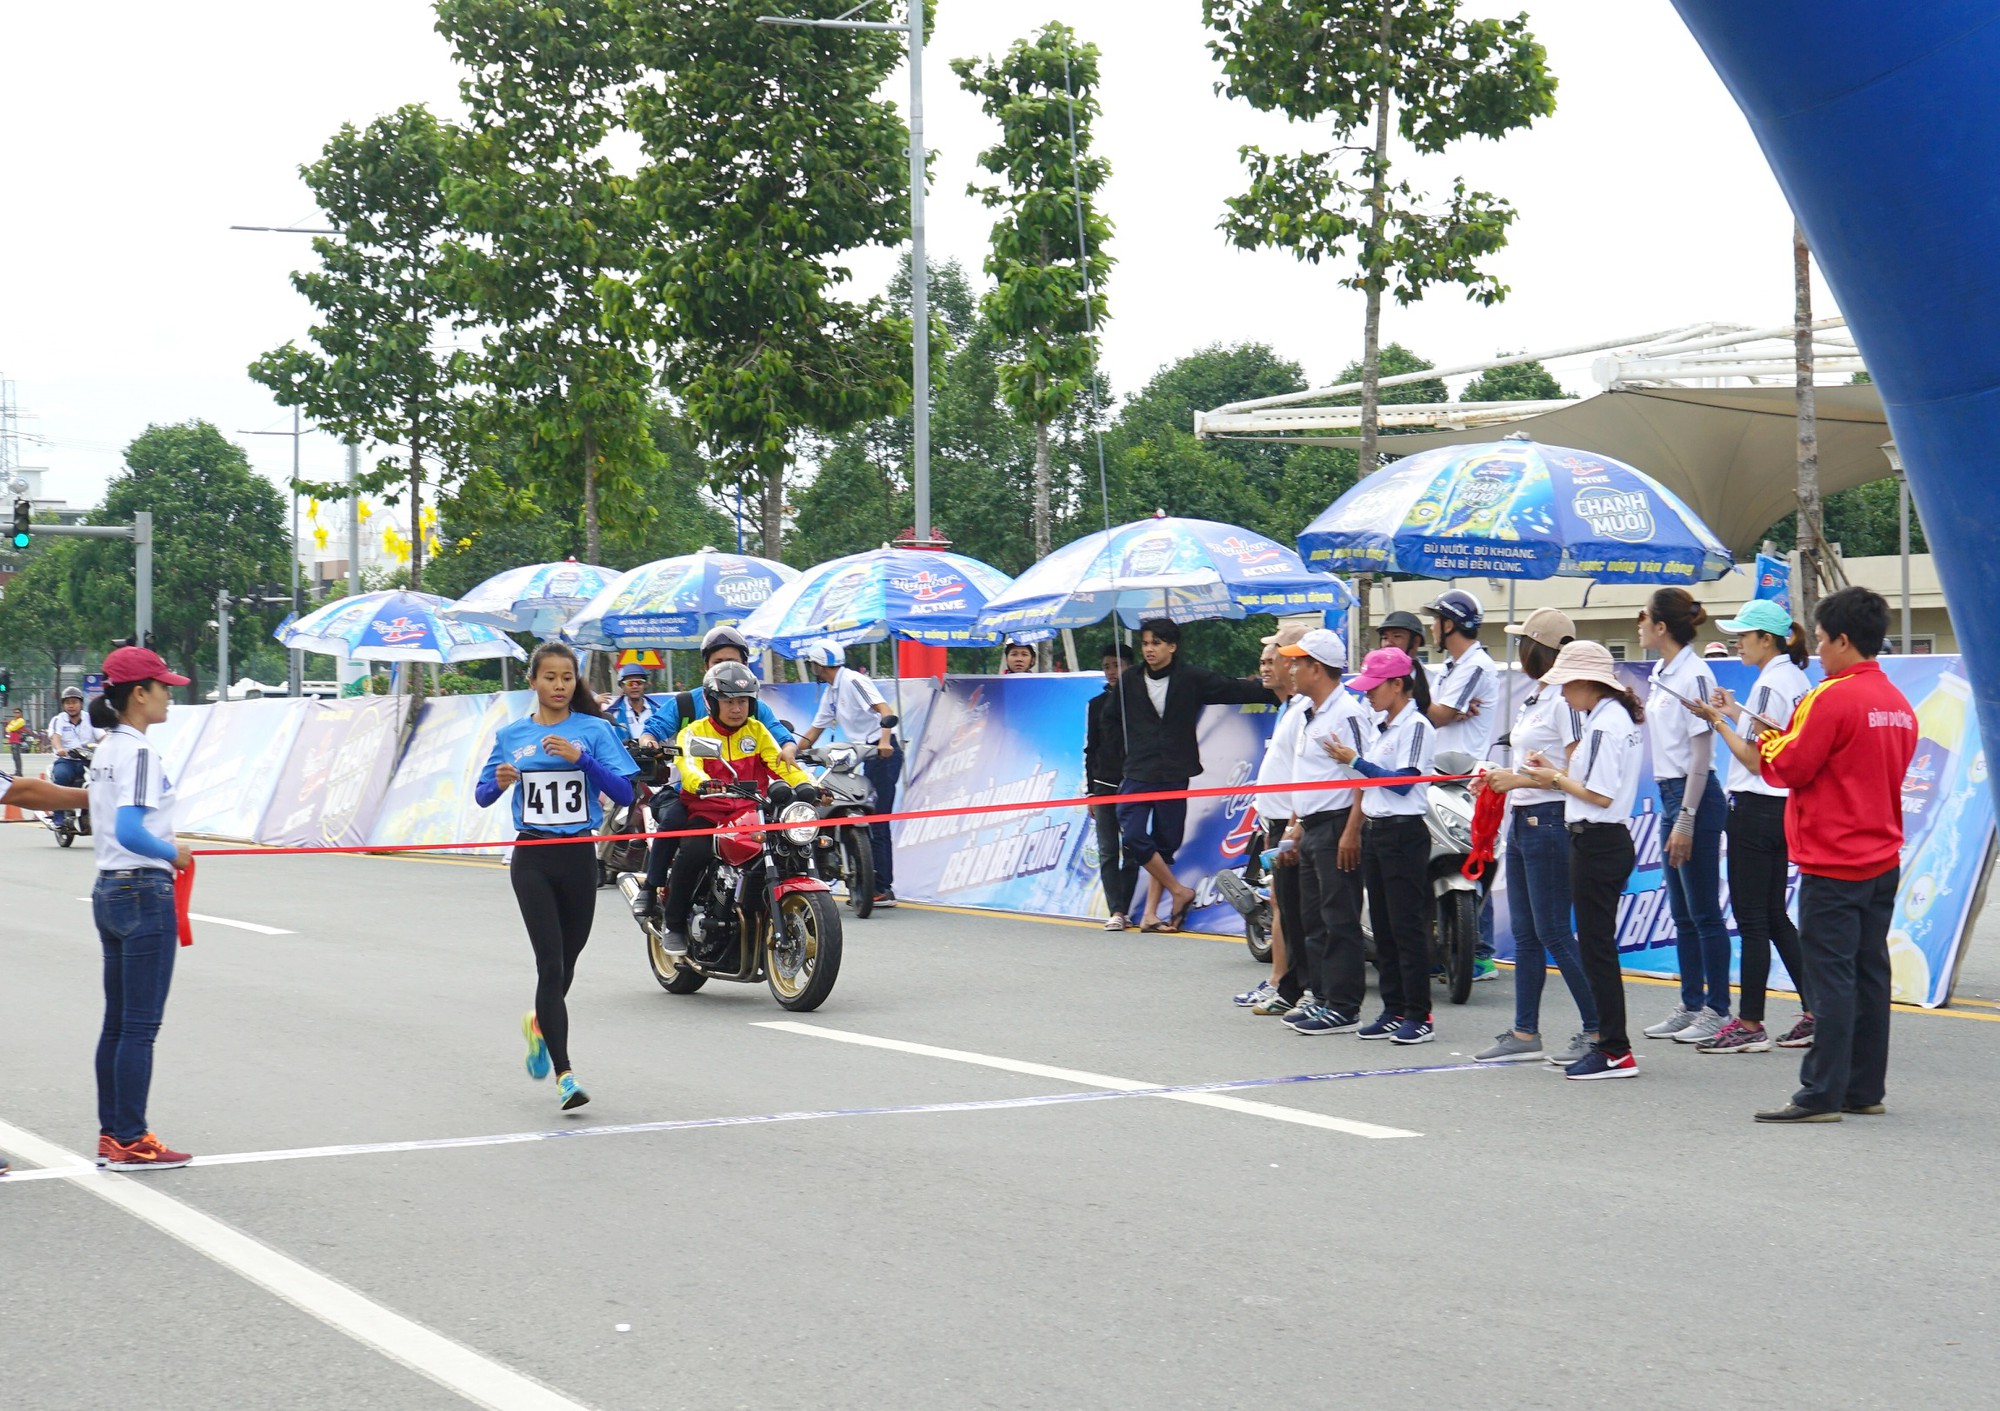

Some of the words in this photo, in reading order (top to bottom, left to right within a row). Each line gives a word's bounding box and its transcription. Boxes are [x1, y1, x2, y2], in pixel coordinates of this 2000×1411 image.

[1572, 475, 1611, 485] ACTIVE
[1574, 492, 1648, 518] CHANH
[1241, 563, 1292, 577] ACTIVE
[716, 577, 771, 596] CHANH
[890, 574, 962, 593] Number
[910, 599, 967, 614] ACTIVE
[528, 780, 582, 814] 413
